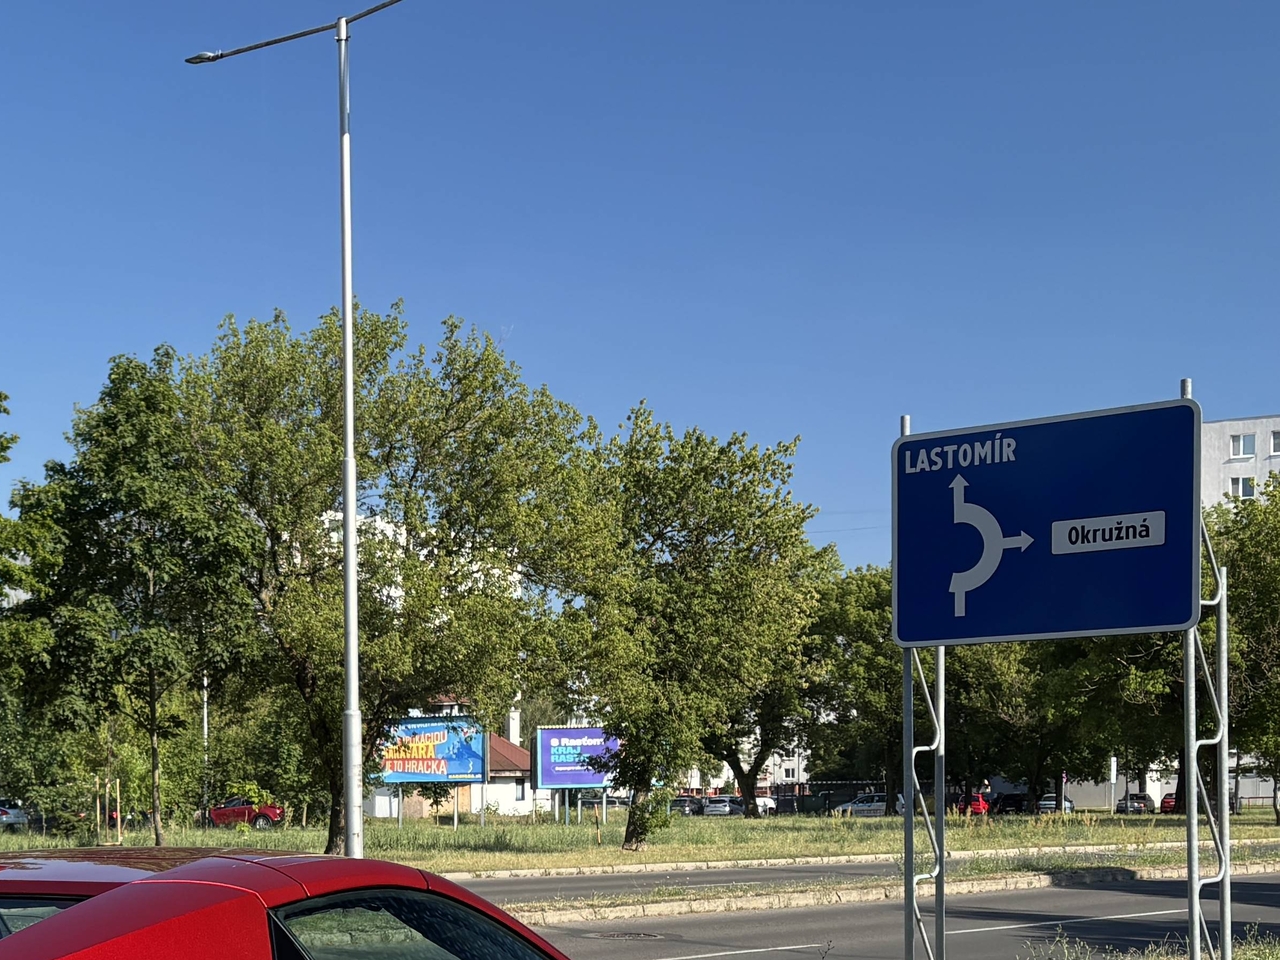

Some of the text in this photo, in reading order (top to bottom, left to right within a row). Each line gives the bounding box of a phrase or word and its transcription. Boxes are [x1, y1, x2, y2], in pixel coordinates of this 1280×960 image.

[904, 432, 1017, 474] LASTOMÍR
[1067, 518, 1151, 545] Okružná
[551, 747, 581, 755] KRAJ
[394, 760, 403, 772] TO
